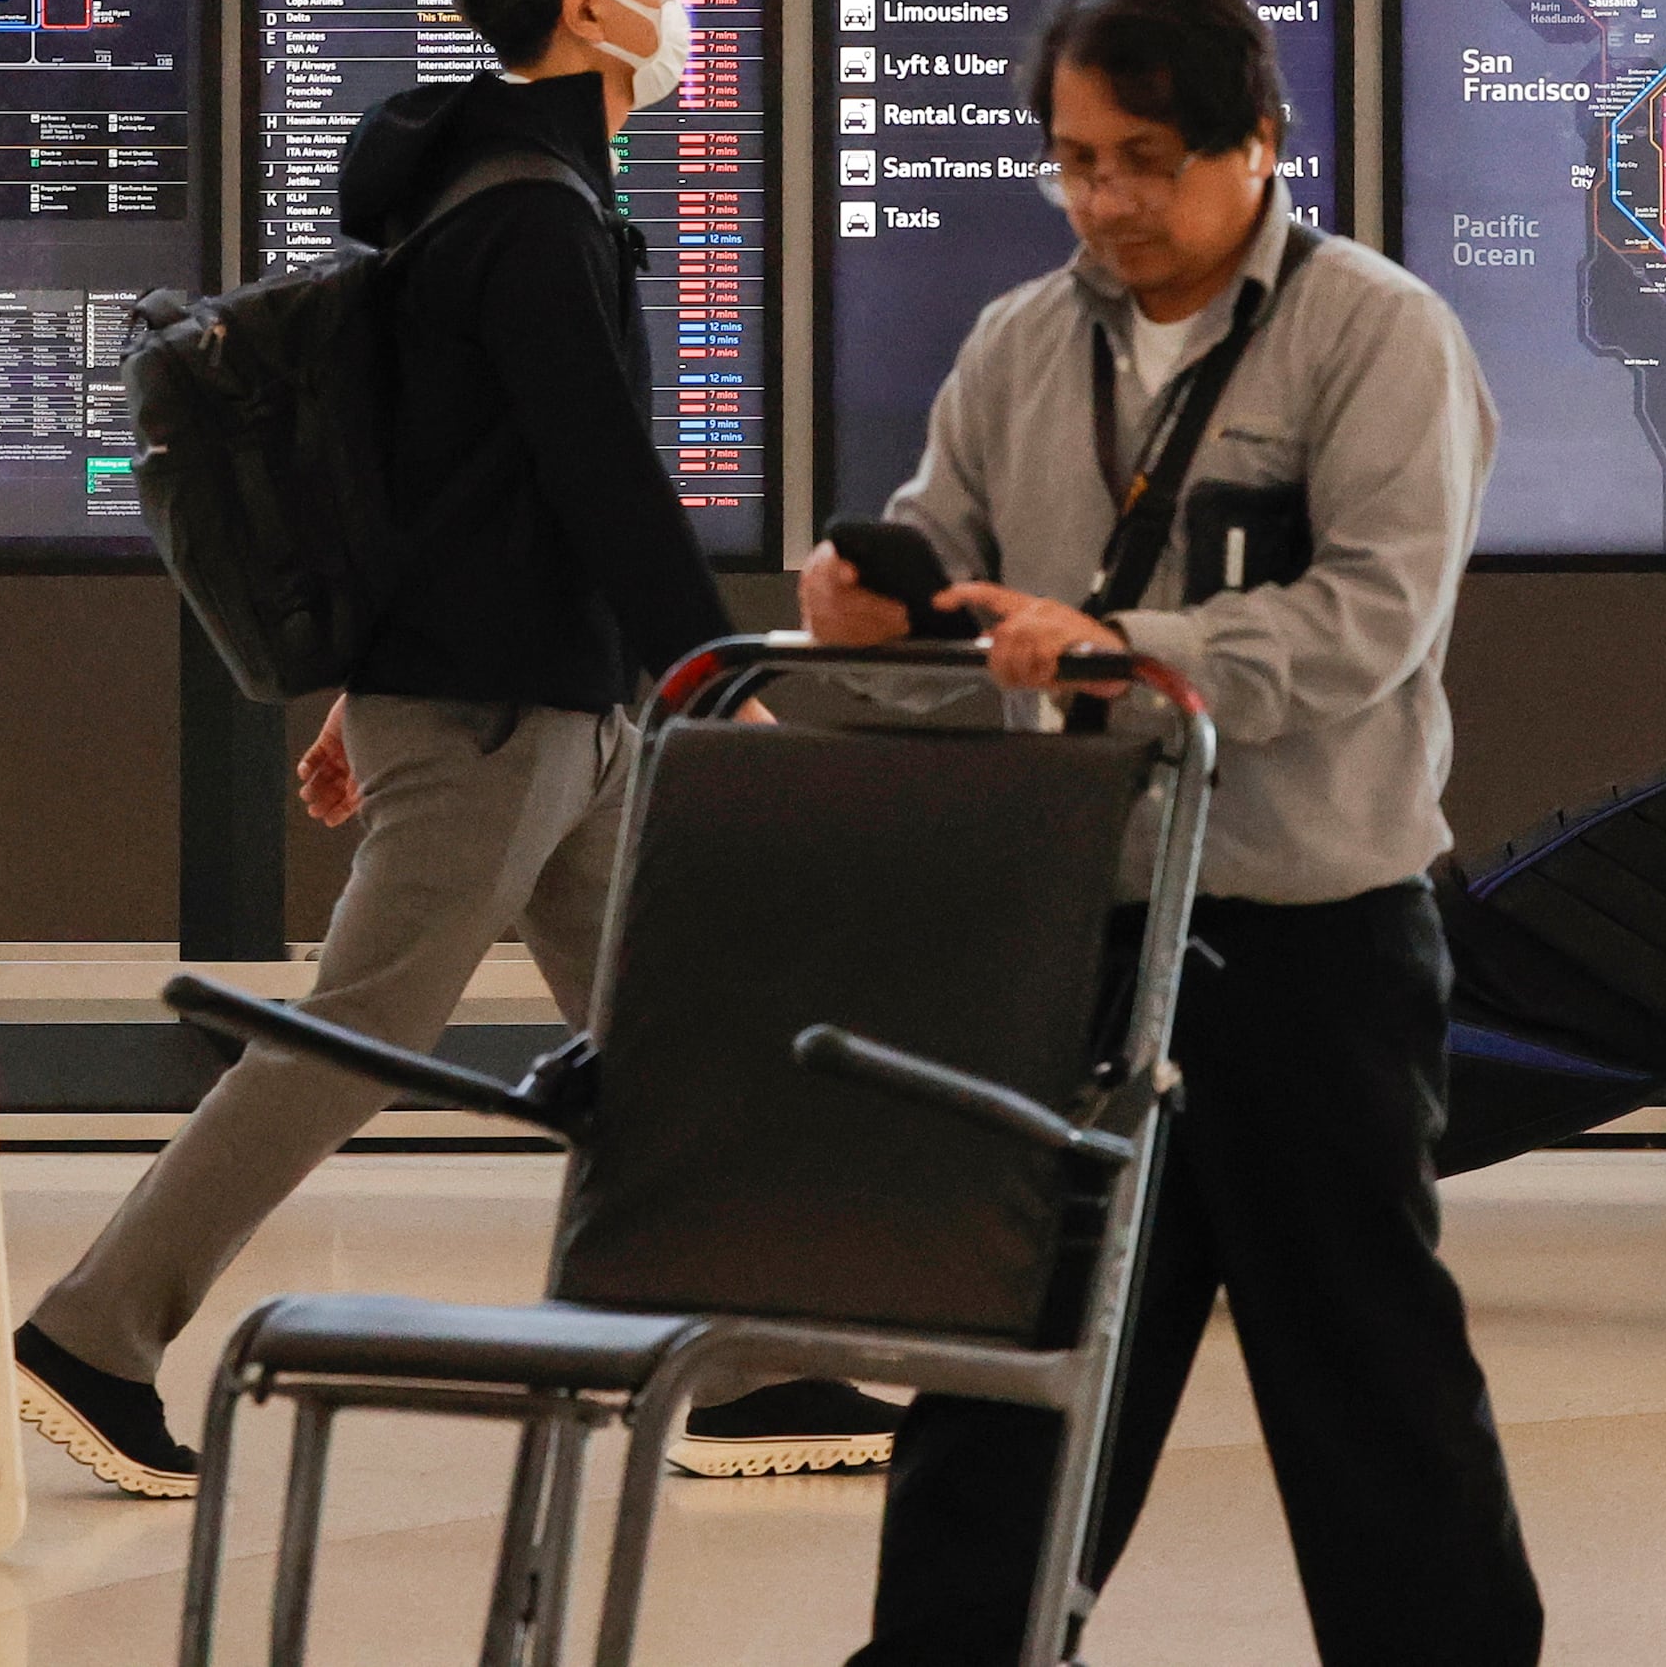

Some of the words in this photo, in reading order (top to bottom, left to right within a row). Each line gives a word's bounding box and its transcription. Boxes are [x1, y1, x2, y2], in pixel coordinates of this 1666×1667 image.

[884, 0, 1009, 22] Limousines
[884, 53, 930, 80] Lyft
[933, 55, 951, 76] &
[954, 53, 1009, 75] Uber
[1462, 48, 1513, 74] San
[1464, 77, 1591, 102] Francisco
[882, 206, 941, 228] Taxis
[1453, 214, 1540, 238] Pacific
[1453, 242, 1535, 266] Ocean
